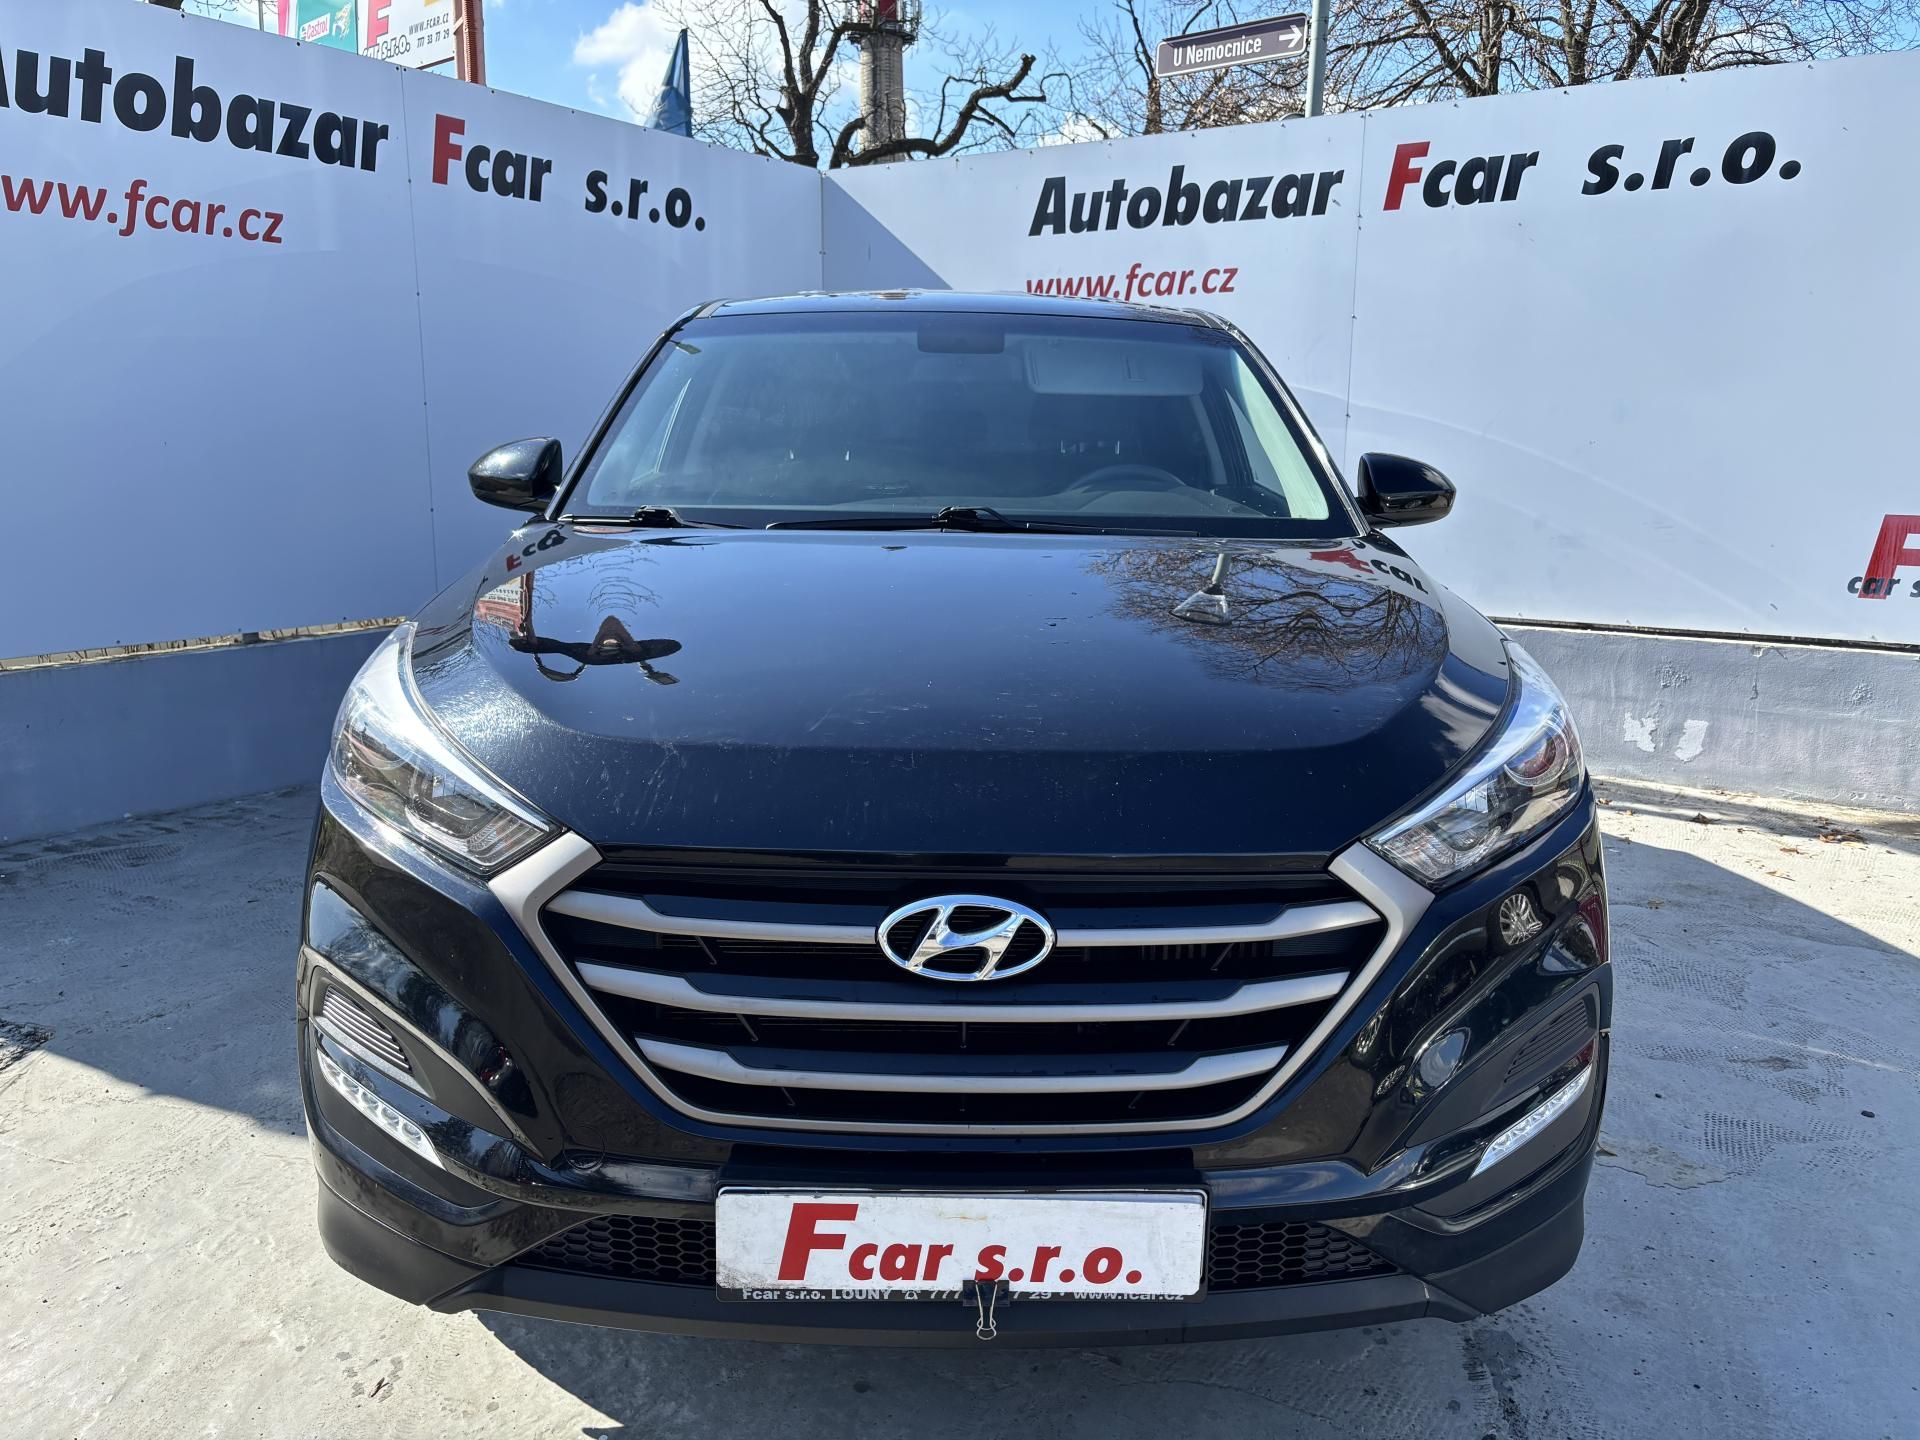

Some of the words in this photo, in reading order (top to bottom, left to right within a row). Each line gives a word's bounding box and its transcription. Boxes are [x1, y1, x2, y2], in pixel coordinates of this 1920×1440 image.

[306, 17, 328, 40] Castrol
[408, 12, 449, 35] WWW.FCAR.CZ
[427, 33, 433, 45] 33
[443, 28, 450, 40] 29
[1173, 47, 1183, 67] U
[1186, 35, 1262, 65] Nemocnice
[0, 46, 389, 172] utobazar
[432, 113, 553, 202] Fcar
[585, 169, 706, 232] s.r.o.
[1028, 164, 1345, 237] Autobazar
[1382, 140, 1540, 211] Fcar
[1581, 131, 1802, 196] s.r.o.
[1026, 262, 1239, 301] www.fcar.cz
[777, 1202, 954, 1281] Fcar
[974, 1243, 1143, 1285] s.r.o.
[742, 1287, 781, 1300] Fcar
[785, 1289, 826, 1300] s.r.o.
[831, 1288, 891, 1300] LOUNY
